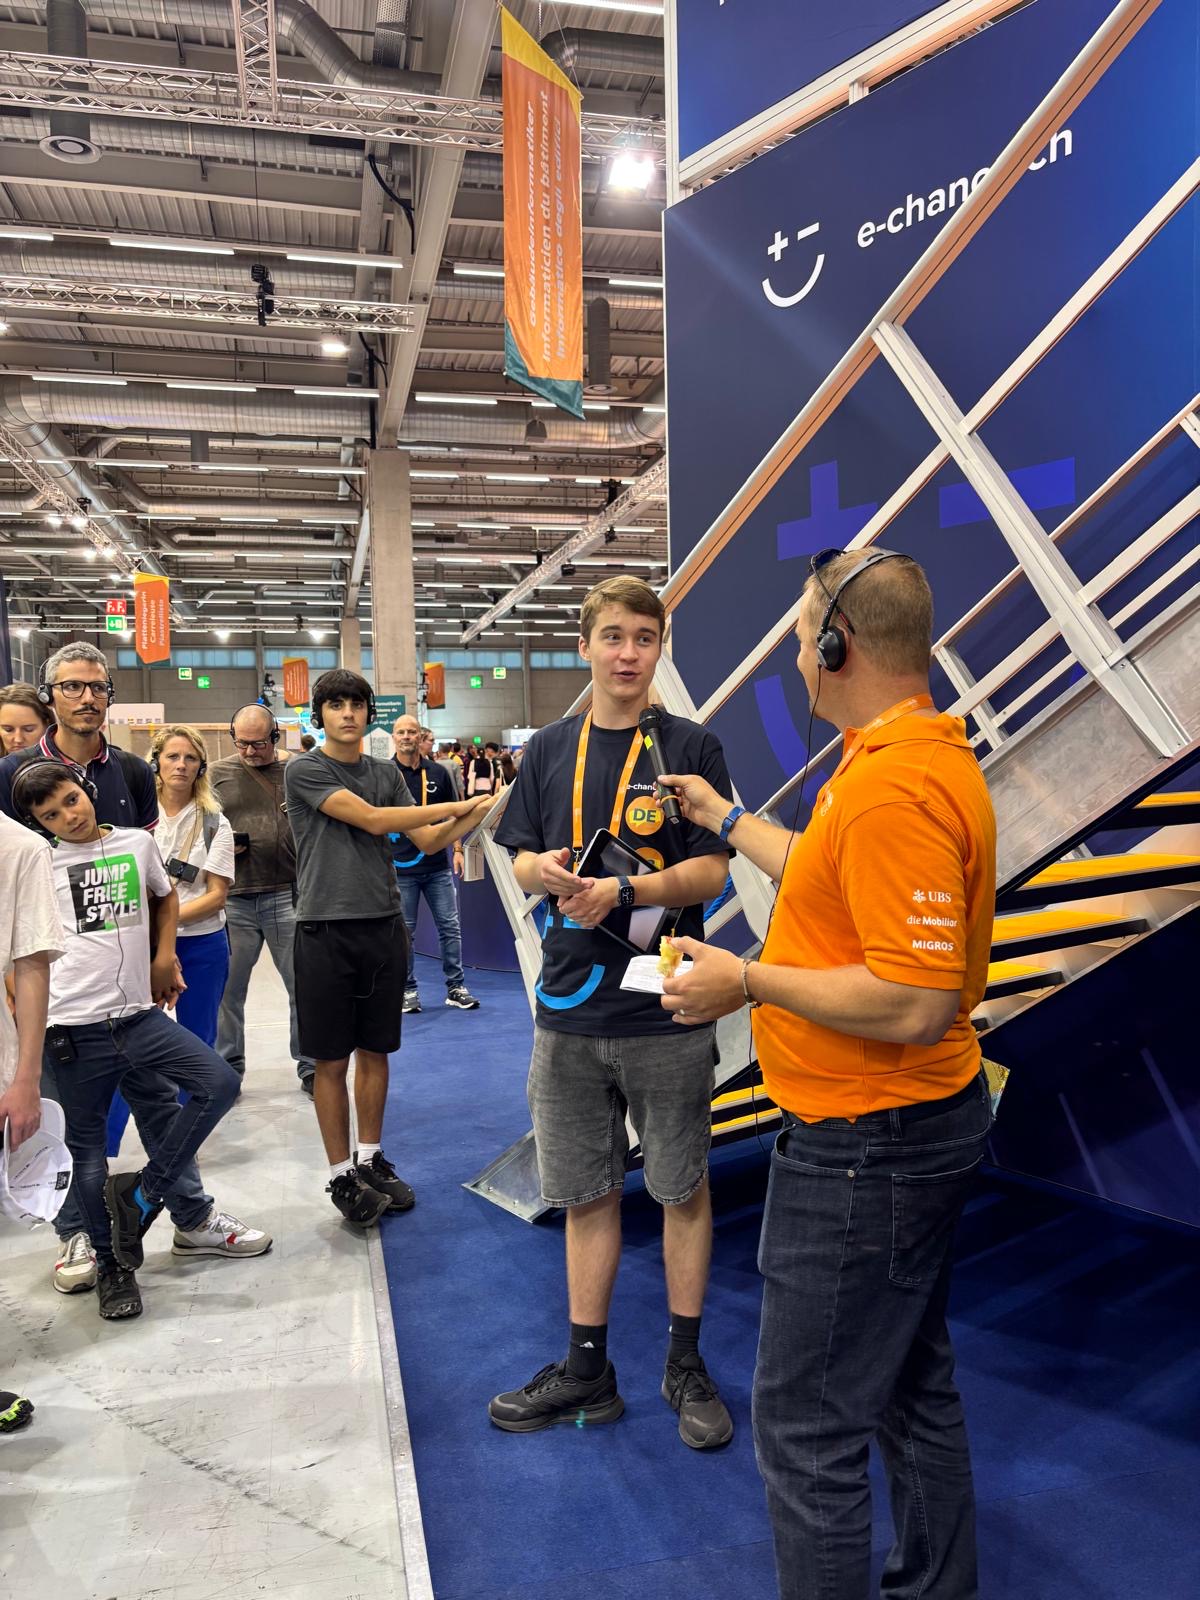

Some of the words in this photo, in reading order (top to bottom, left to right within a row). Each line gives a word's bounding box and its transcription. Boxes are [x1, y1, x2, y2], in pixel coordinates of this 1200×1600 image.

[540, 90, 551, 187] bâtiment
[553, 115, 562, 183] edifici
[526, 101, 537, 328] Gebäudeinformatiker
[540, 193, 551, 220] du
[554, 187, 564, 237] degli
[540, 227, 551, 363] Informaticien
[555, 243, 567, 360] Informatico
[633, 808, 657, 823] DE
[79, 862, 131, 888] JUMP
[83, 881, 128, 907] FREE
[928, 891, 952, 903] UBS
[85, 898, 138, 923] STYLE
[906, 915, 921, 925] die
[922, 915, 958, 927] Mobiliar
[912, 940, 954, 951] MIGROS
